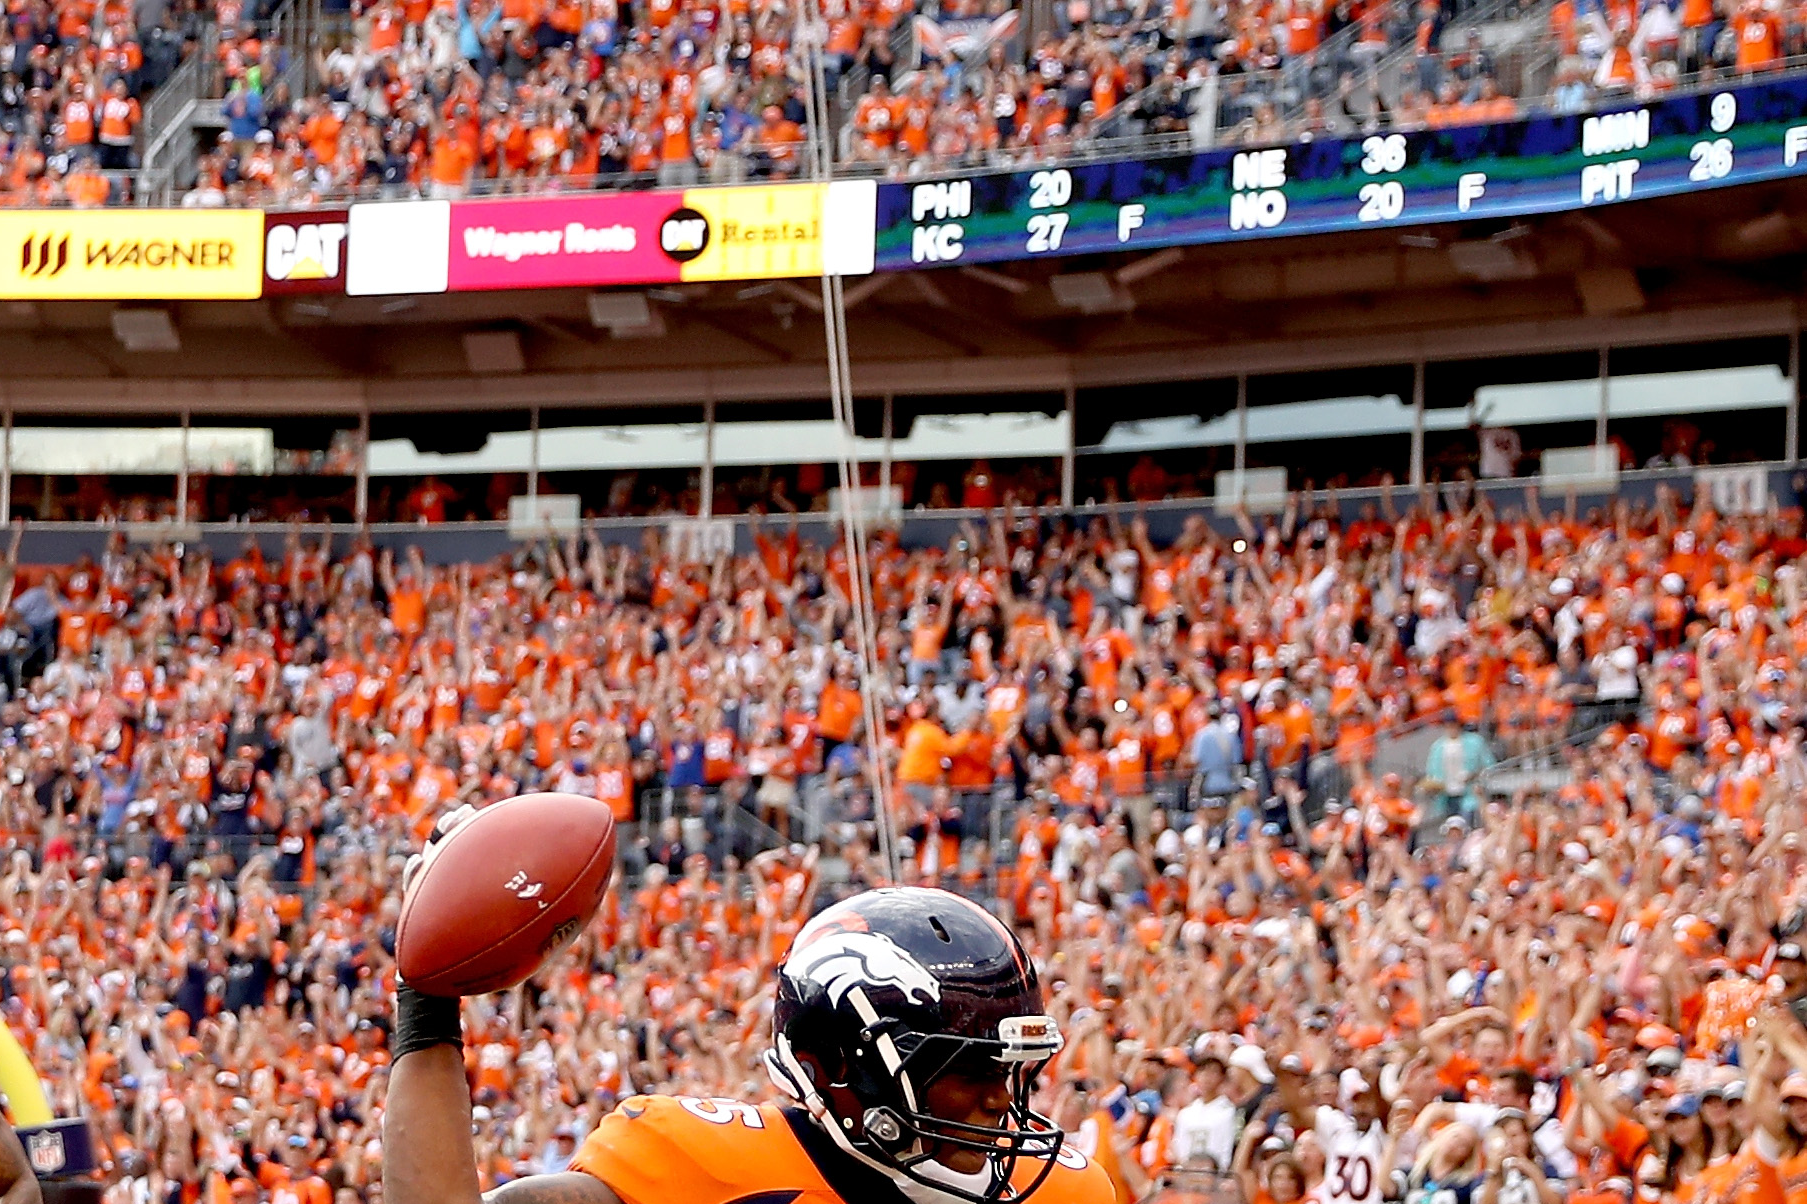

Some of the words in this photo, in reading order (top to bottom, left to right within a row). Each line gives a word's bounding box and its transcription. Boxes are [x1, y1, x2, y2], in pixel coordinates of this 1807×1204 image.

[1582, 108, 1651, 157] MIN
[1710, 91, 1737, 133] 9
[1231, 148, 1288, 190] NE
[1360, 133, 1408, 175] 36
[1580, 158, 1641, 206] PIT
[1688, 137, 1734, 182] 26
[1783, 126, 1807, 168] F
[911, 179, 973, 221] PHI
[1028, 169, 1072, 209] 20
[1229, 189, 1288, 231] NO
[1358, 180, 1405, 222] 20
[1457, 172, 1488, 213] F
[85, 240, 235, 267] WAGNER
[266, 223, 346, 281] CAT
[464, 225, 562, 262] Wagner
[565, 221, 636, 254] Rents
[661, 218, 707, 252] CAT
[721, 219, 819, 243] Rental
[911, 223, 965, 263] KC
[1025, 212, 1070, 253] 27
[1117, 203, 1146, 242] F
[1330, 1153, 1373, 1202] 30
